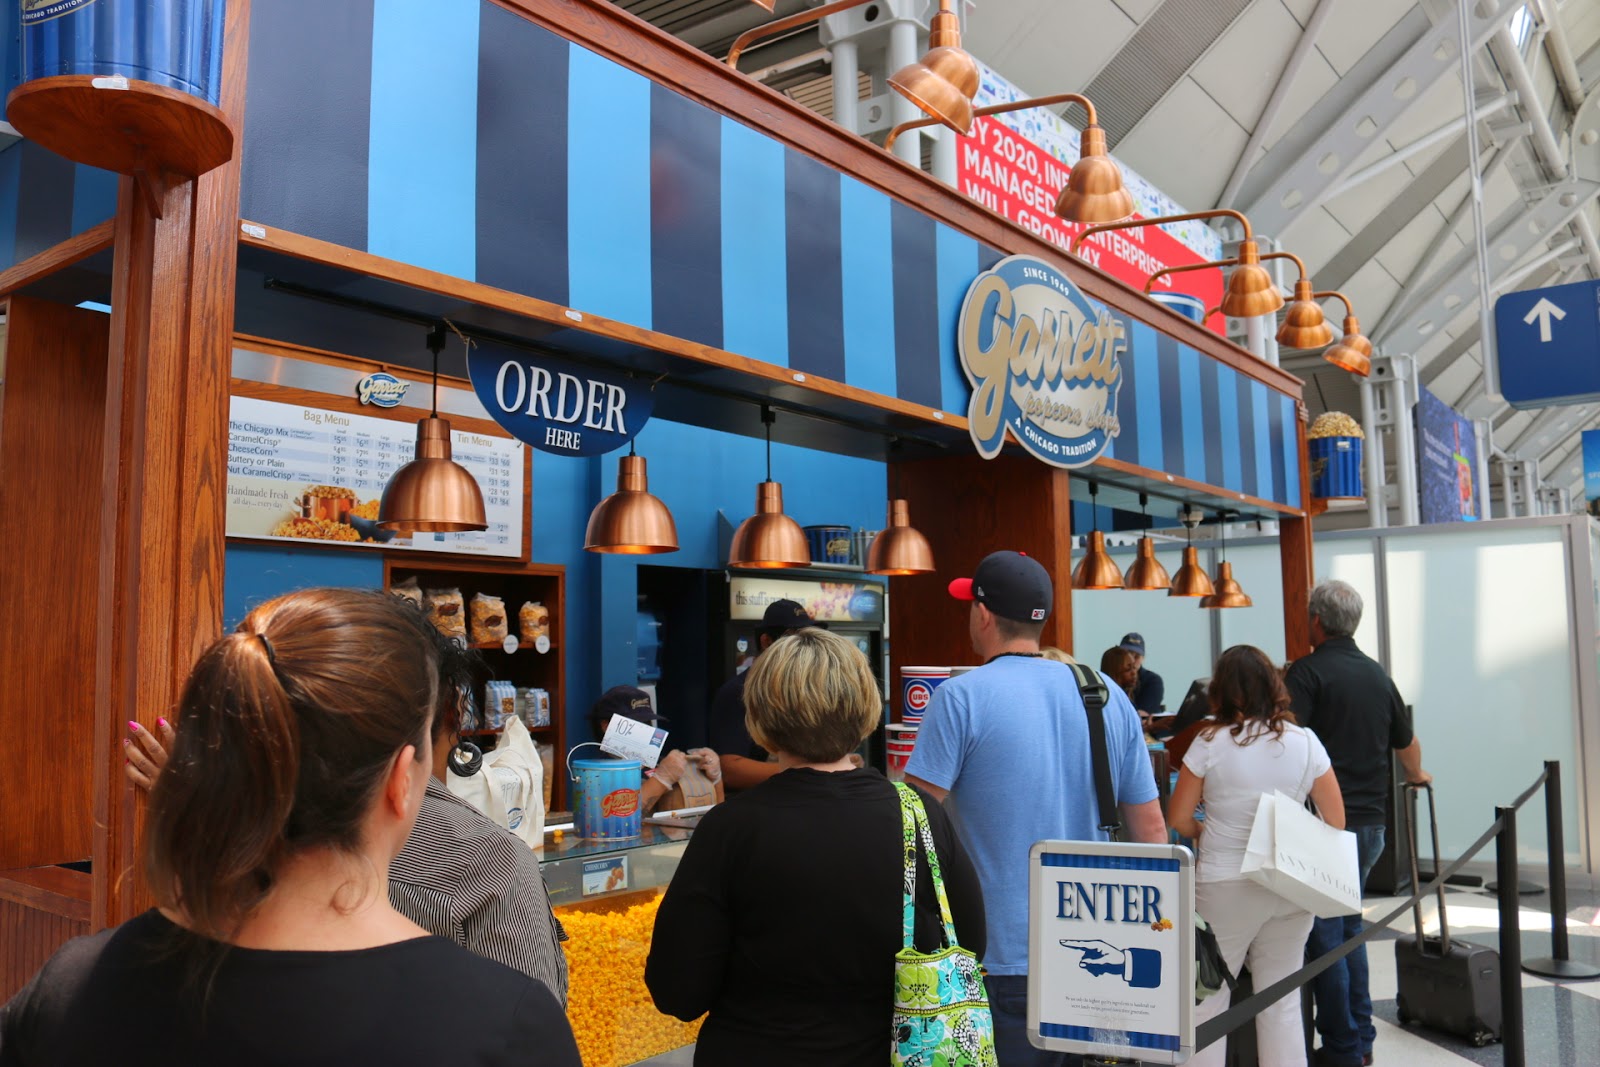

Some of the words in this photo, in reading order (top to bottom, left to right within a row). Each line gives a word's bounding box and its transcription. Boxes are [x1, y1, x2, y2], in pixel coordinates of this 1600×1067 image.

[993, 128, 1042, 184] 2020,
[964, 143, 1057, 219] MANAGED
[1023, 266, 1048, 282] SINCE
[1050, 276, 1070, 296] 1949
[963, 273, 1127, 442] Garrett
[495, 360, 627, 435] ORDER
[229, 421, 242, 431] The
[243, 423, 274, 436] Chicago
[275, 427, 289, 437] Mix
[303, 410, 322, 425] Bag
[324, 413, 350, 426] Menu
[457, 433, 469, 443] Tin
[471, 436, 493, 447] Menu
[544, 427, 581, 451] HERE
[1015, 416, 1022, 429] A
[1024, 425, 1059, 454] CHICAGO
[1061, 437, 1097, 456] TRADITION
[227, 465, 241, 474] Nut
[267, 458, 285, 468] Plain
[227, 484, 268, 498] Handmade
[269, 489, 289, 500] Fresh
[908, 685, 929, 709] CUBS
[615, 718, 635, 736] 10%
[1278, 851, 1306, 871] ANN
[1311, 865, 1360, 900] TAYLOR
[1055, 880, 1162, 924] ENTER
